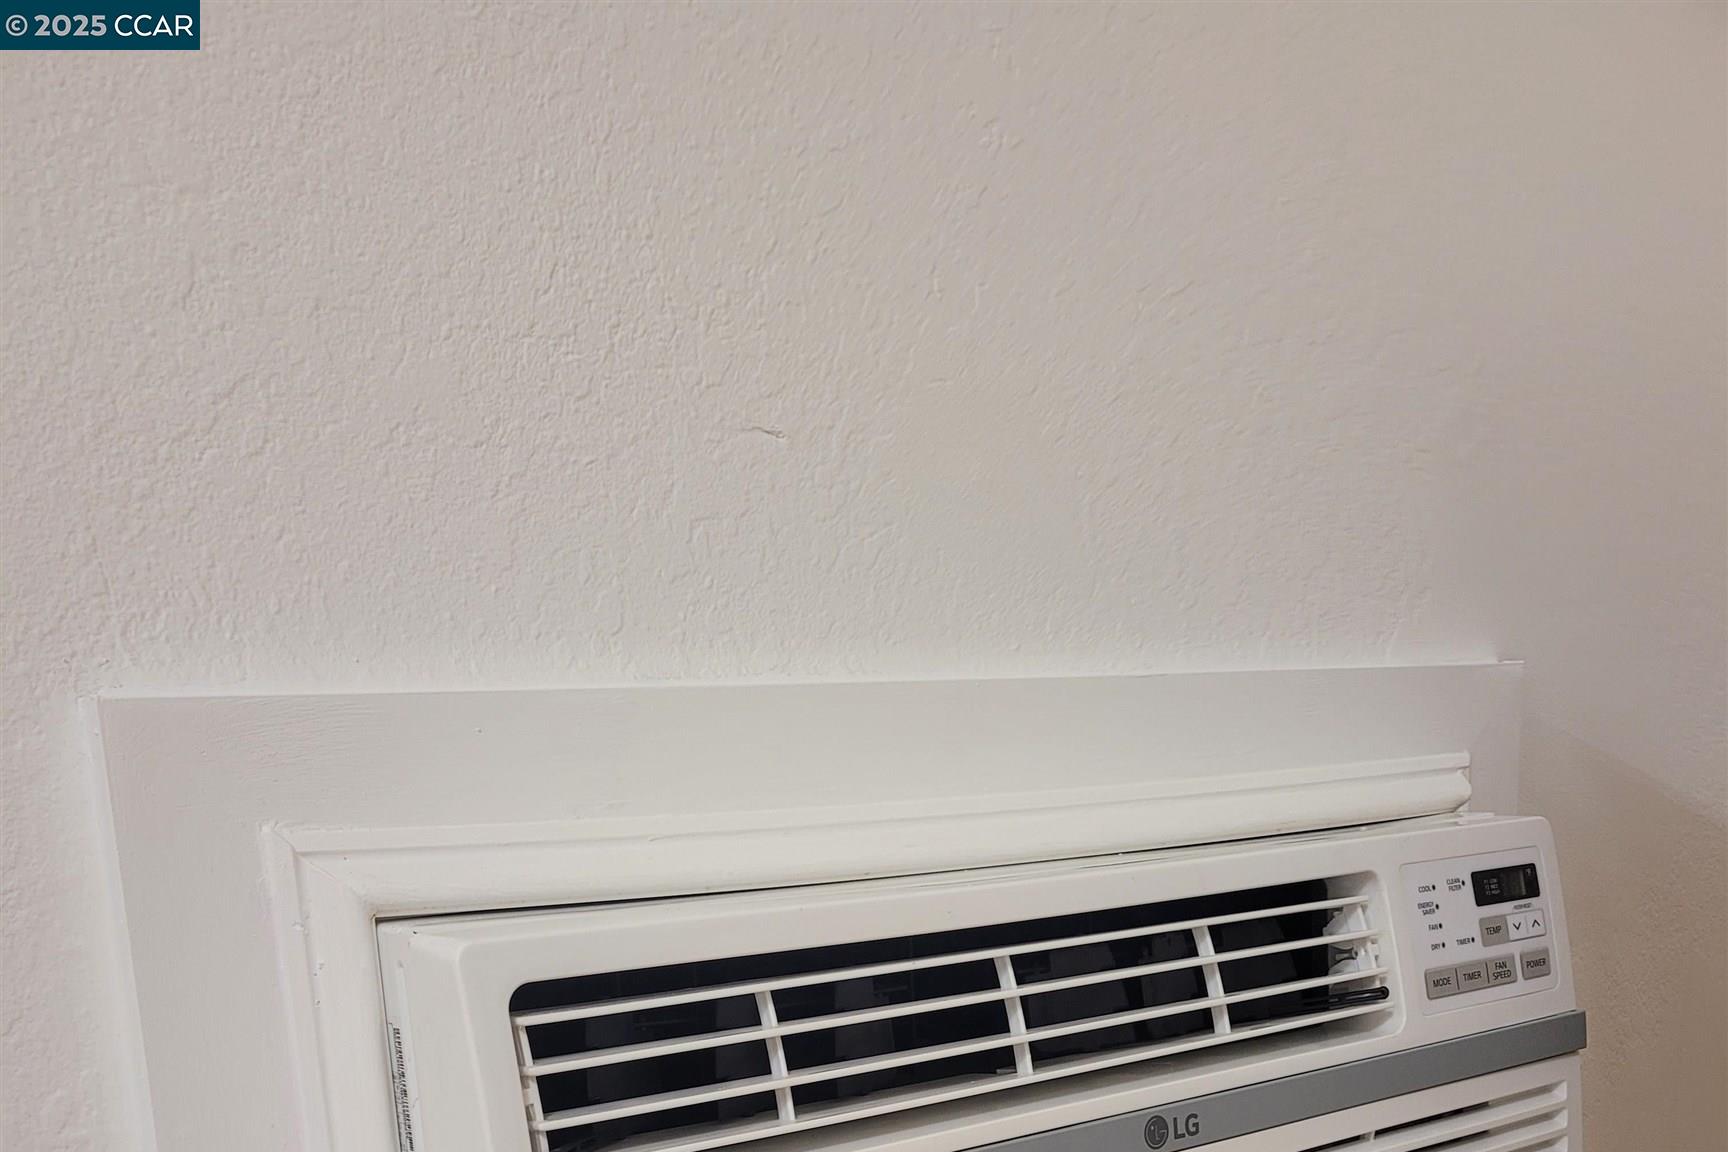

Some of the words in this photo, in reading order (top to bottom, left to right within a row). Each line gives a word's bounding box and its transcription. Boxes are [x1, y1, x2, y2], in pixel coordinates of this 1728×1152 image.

[1446, 878, 1461, 886] CLEAN
[1418, 885, 1432, 893] COOL
[1486, 926, 1502, 935] TEMP
[1431, 943, 1440, 951] DRY
[1495, 961, 1507, 970] FAN
[1526, 958, 1546, 969] POWER
[1463, 971, 1482, 982] TIMER
[1493, 970, 1511, 981] SPEED
[1433, 976, 1452, 987] MODE
[1173, 1113, 1200, 1140] LG
